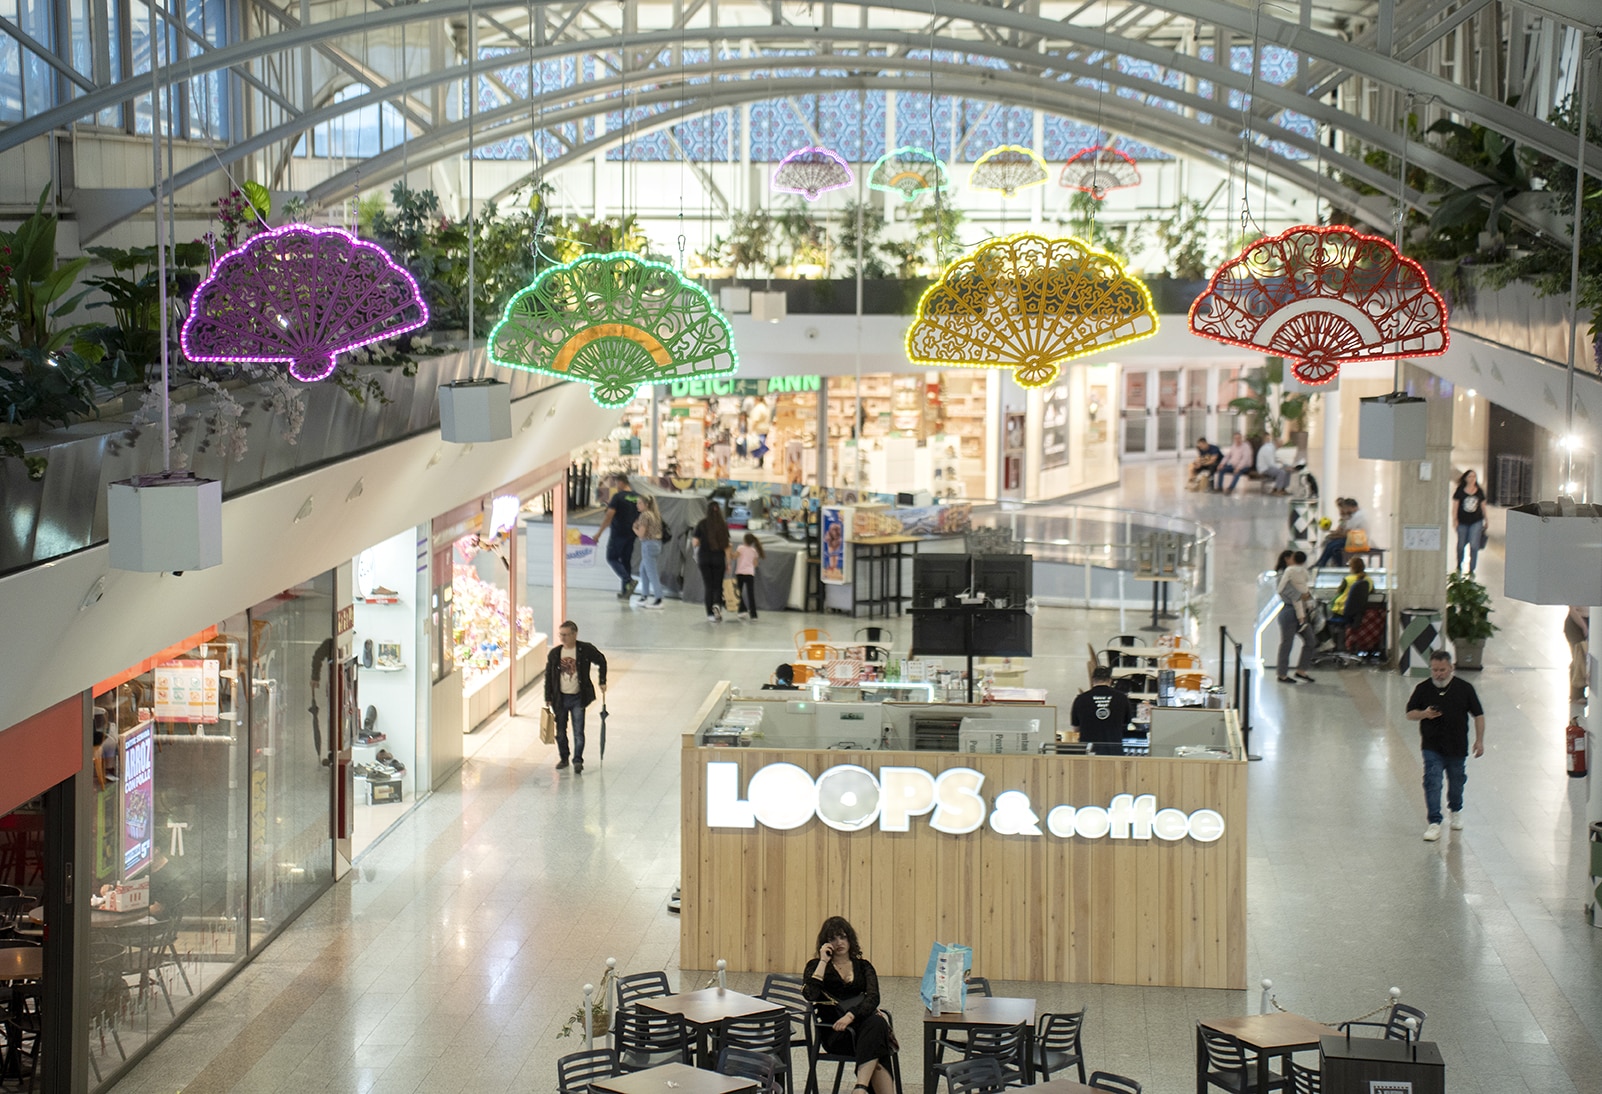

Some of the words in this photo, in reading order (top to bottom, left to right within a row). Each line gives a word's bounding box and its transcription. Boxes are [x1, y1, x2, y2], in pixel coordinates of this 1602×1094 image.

[671, 375, 821, 397] DEICANN
[125, 737, 151, 782] ARROZ
[995, 734, 1004, 754] Penta
[707, 762, 986, 834] LOOPS
[989, 789, 1043, 836] &
[1047, 793, 1226, 842] coffee
